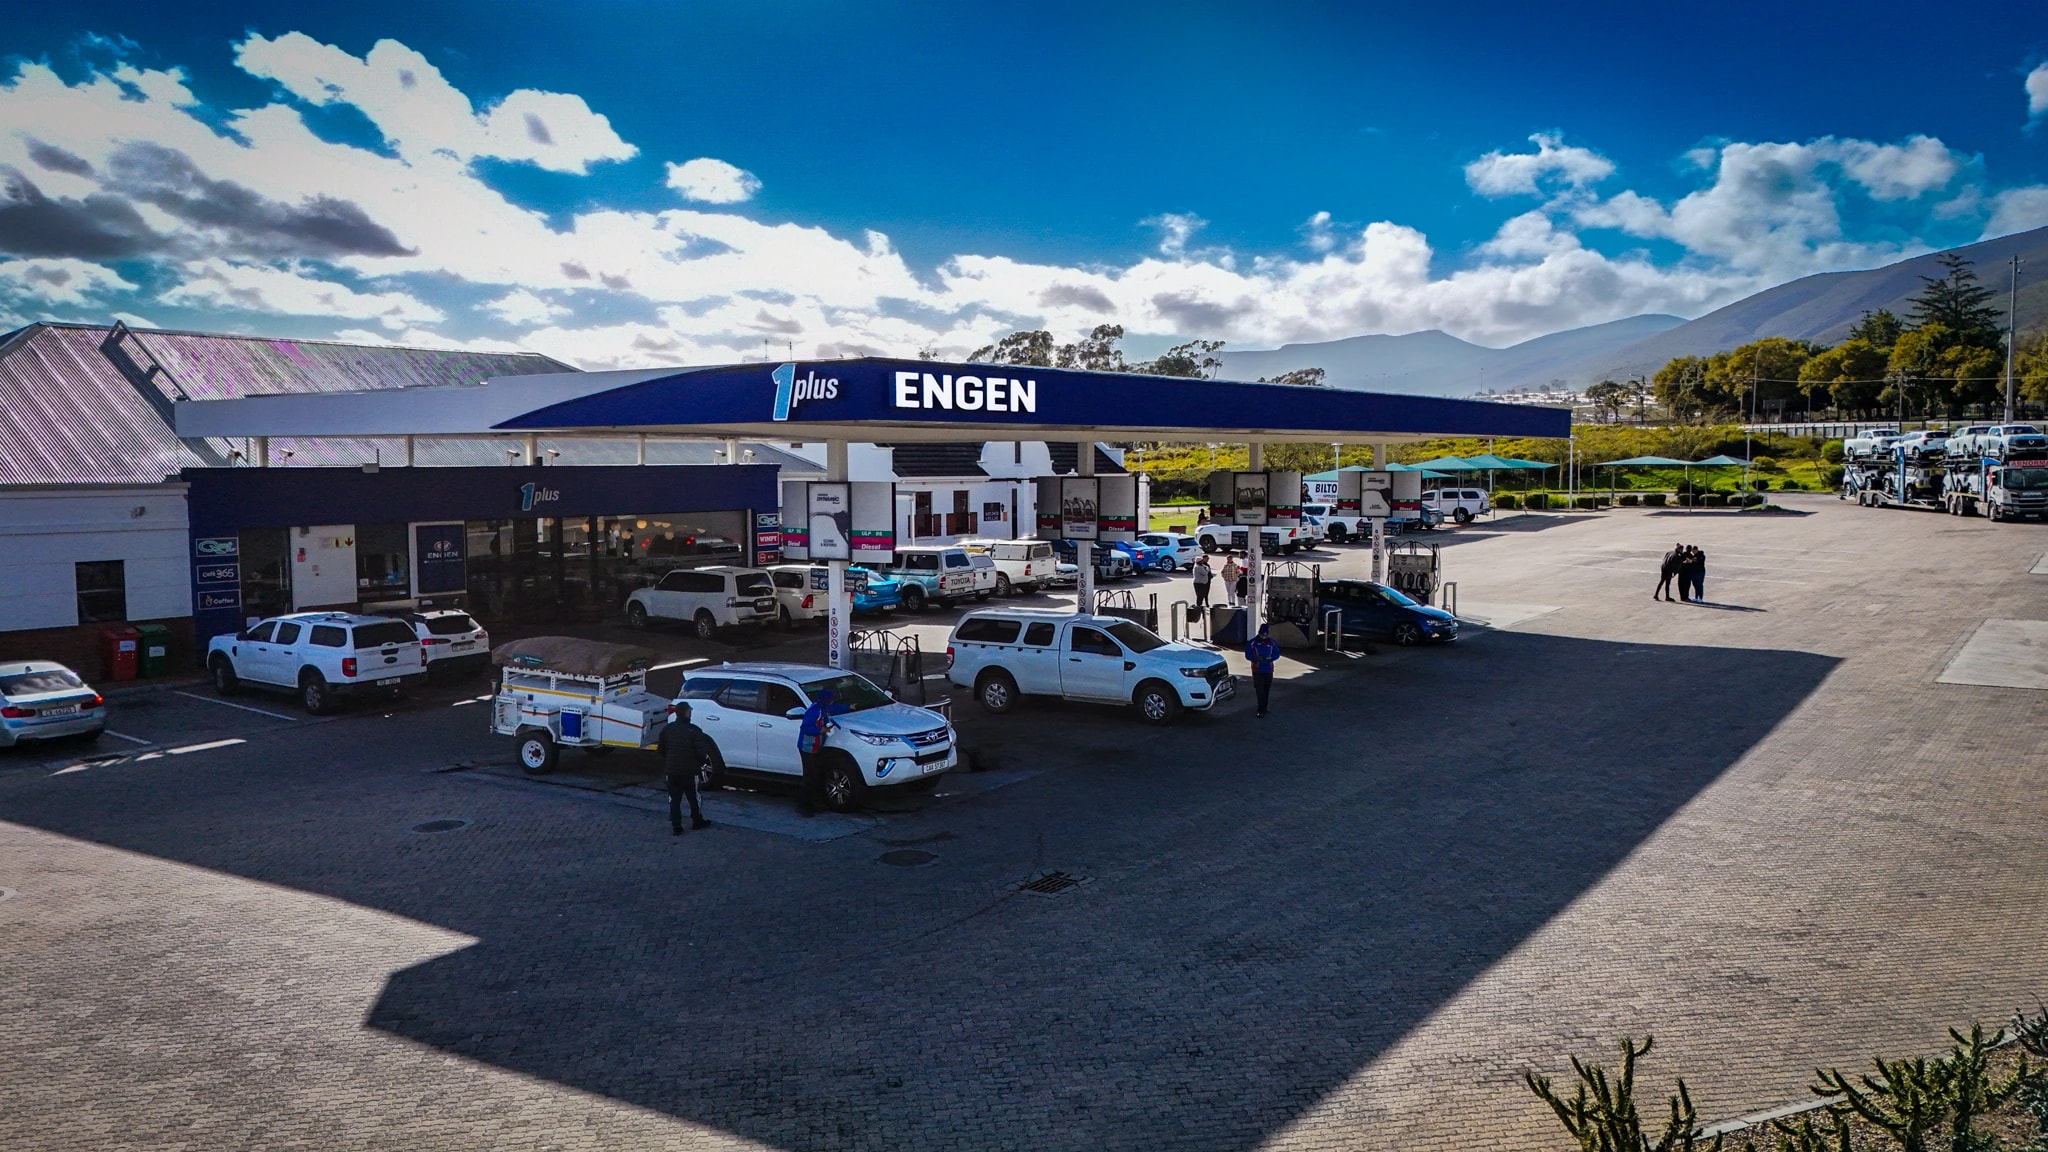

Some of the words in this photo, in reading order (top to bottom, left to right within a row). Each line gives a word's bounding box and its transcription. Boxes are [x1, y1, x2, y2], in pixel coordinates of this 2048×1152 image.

[894, 371, 1037, 413] ENGEN
[520, 482, 561, 511] 1plus
[215, 568, 235, 579] 365
[950, 577, 971, 586] TOYOTA
